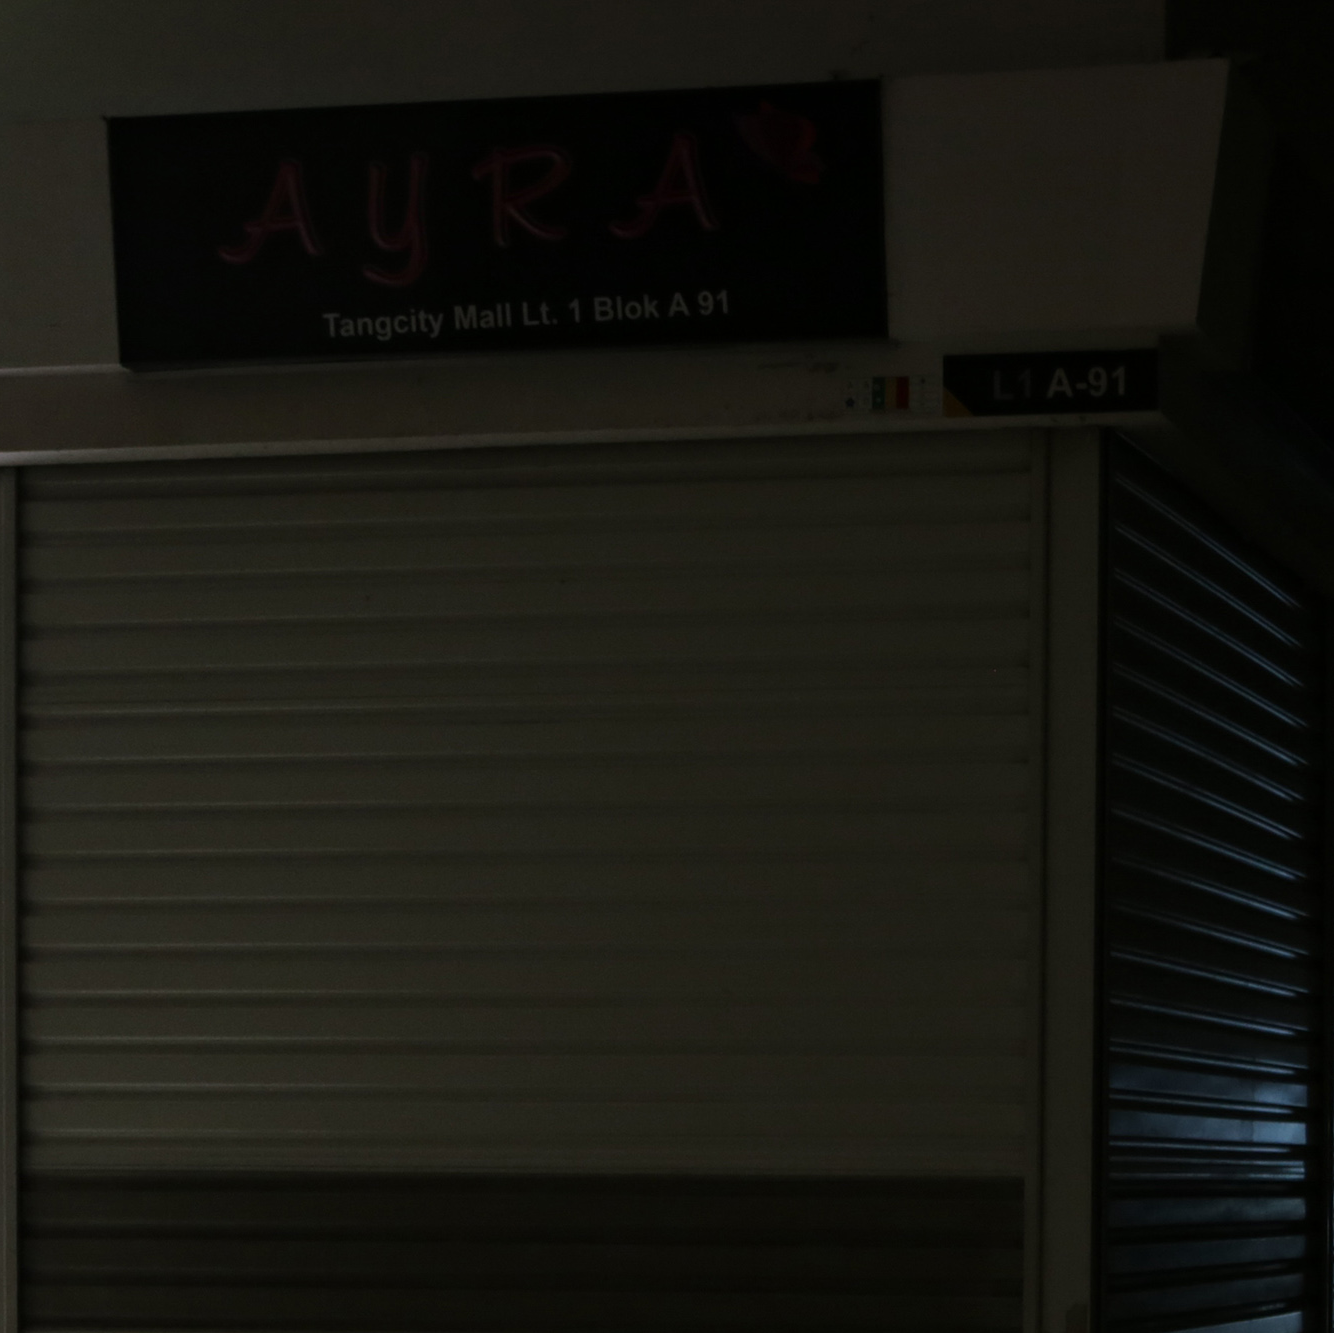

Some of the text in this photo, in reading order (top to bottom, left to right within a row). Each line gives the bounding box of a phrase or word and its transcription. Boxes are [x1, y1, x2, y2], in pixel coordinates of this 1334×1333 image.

[217, 131, 721, 288] AYRA
[321, 289, 730, 342] Tangcity Mall Lt. 1 Blok A 91
[992, 366, 1128, 401] L1 A-91
